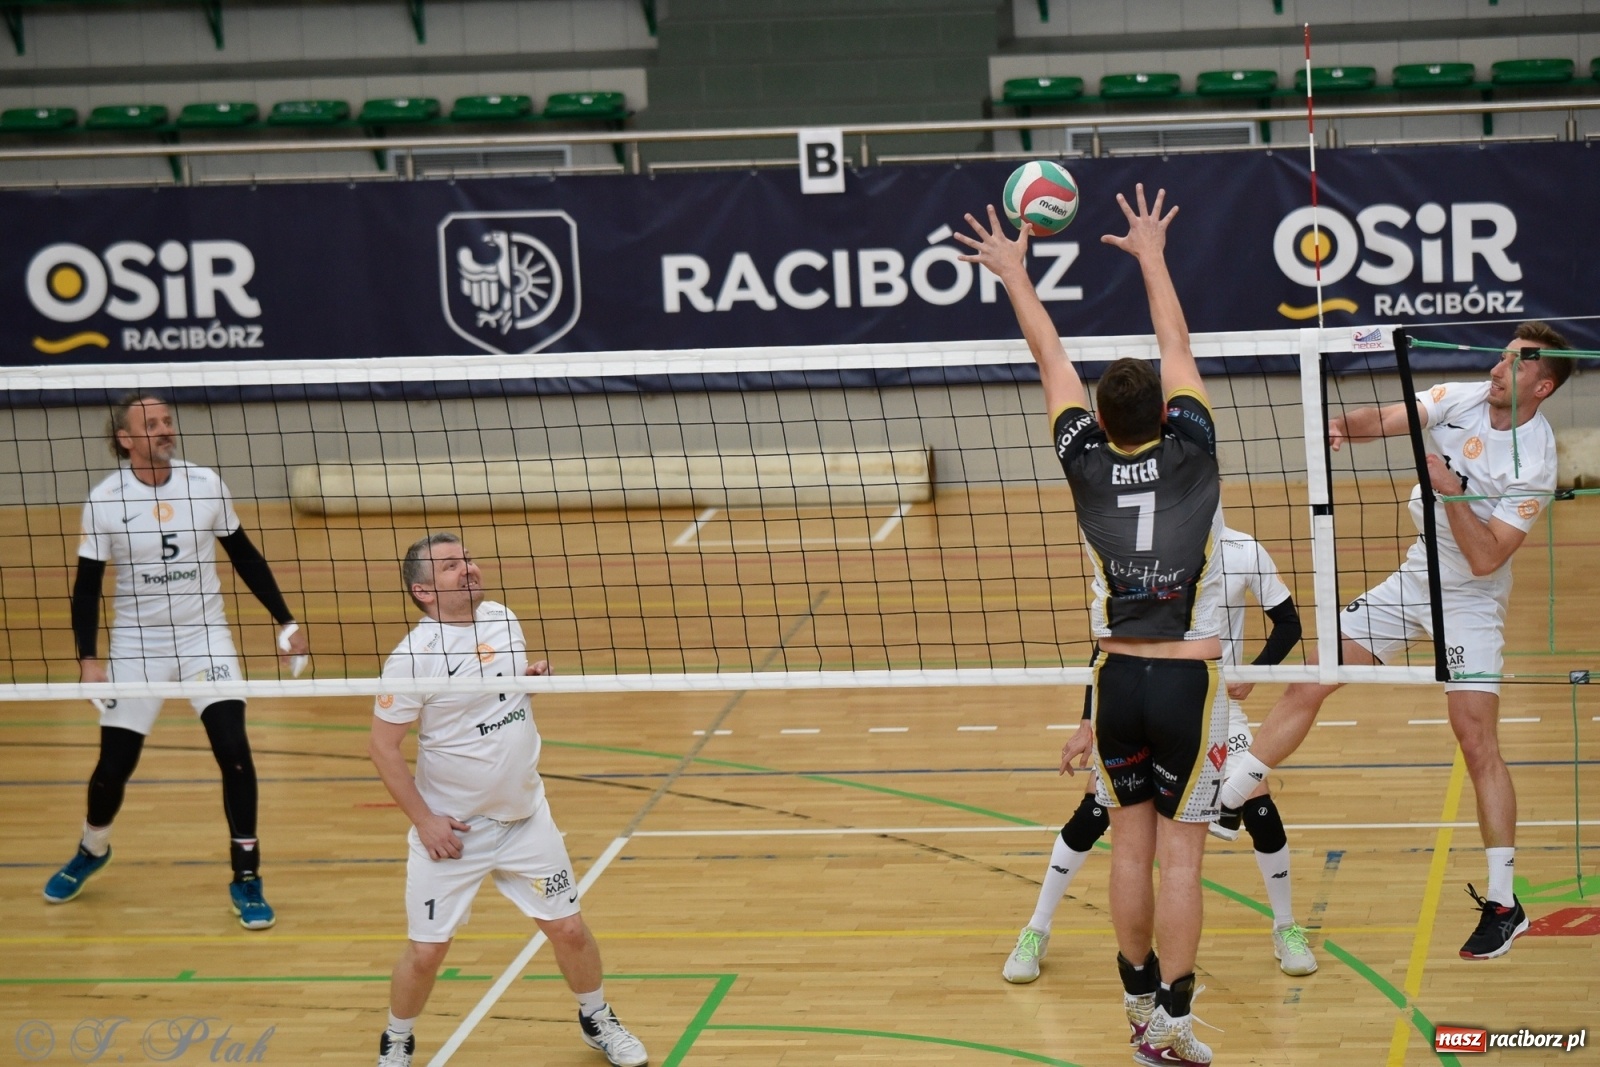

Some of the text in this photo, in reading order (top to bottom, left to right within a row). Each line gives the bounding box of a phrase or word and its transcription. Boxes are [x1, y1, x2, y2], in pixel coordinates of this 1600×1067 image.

[806, 142, 838, 178] B
[1039, 199, 1068, 217] molten
[1374, 285, 1524, 316] RACIBÓRZ
[122, 321, 264, 352] RACIBÓRZ
[1111, 458, 1160, 485] ENTER
[1117, 491, 1156, 552] 7
[161, 533, 180, 561] 5
[141, 569, 198, 585] TropiDog
[1210, 778, 1221, 807] 7
[544, 869, 568, 886] ZOO
[545, 878, 570, 895] MAR
[424, 898, 436, 920] 1
